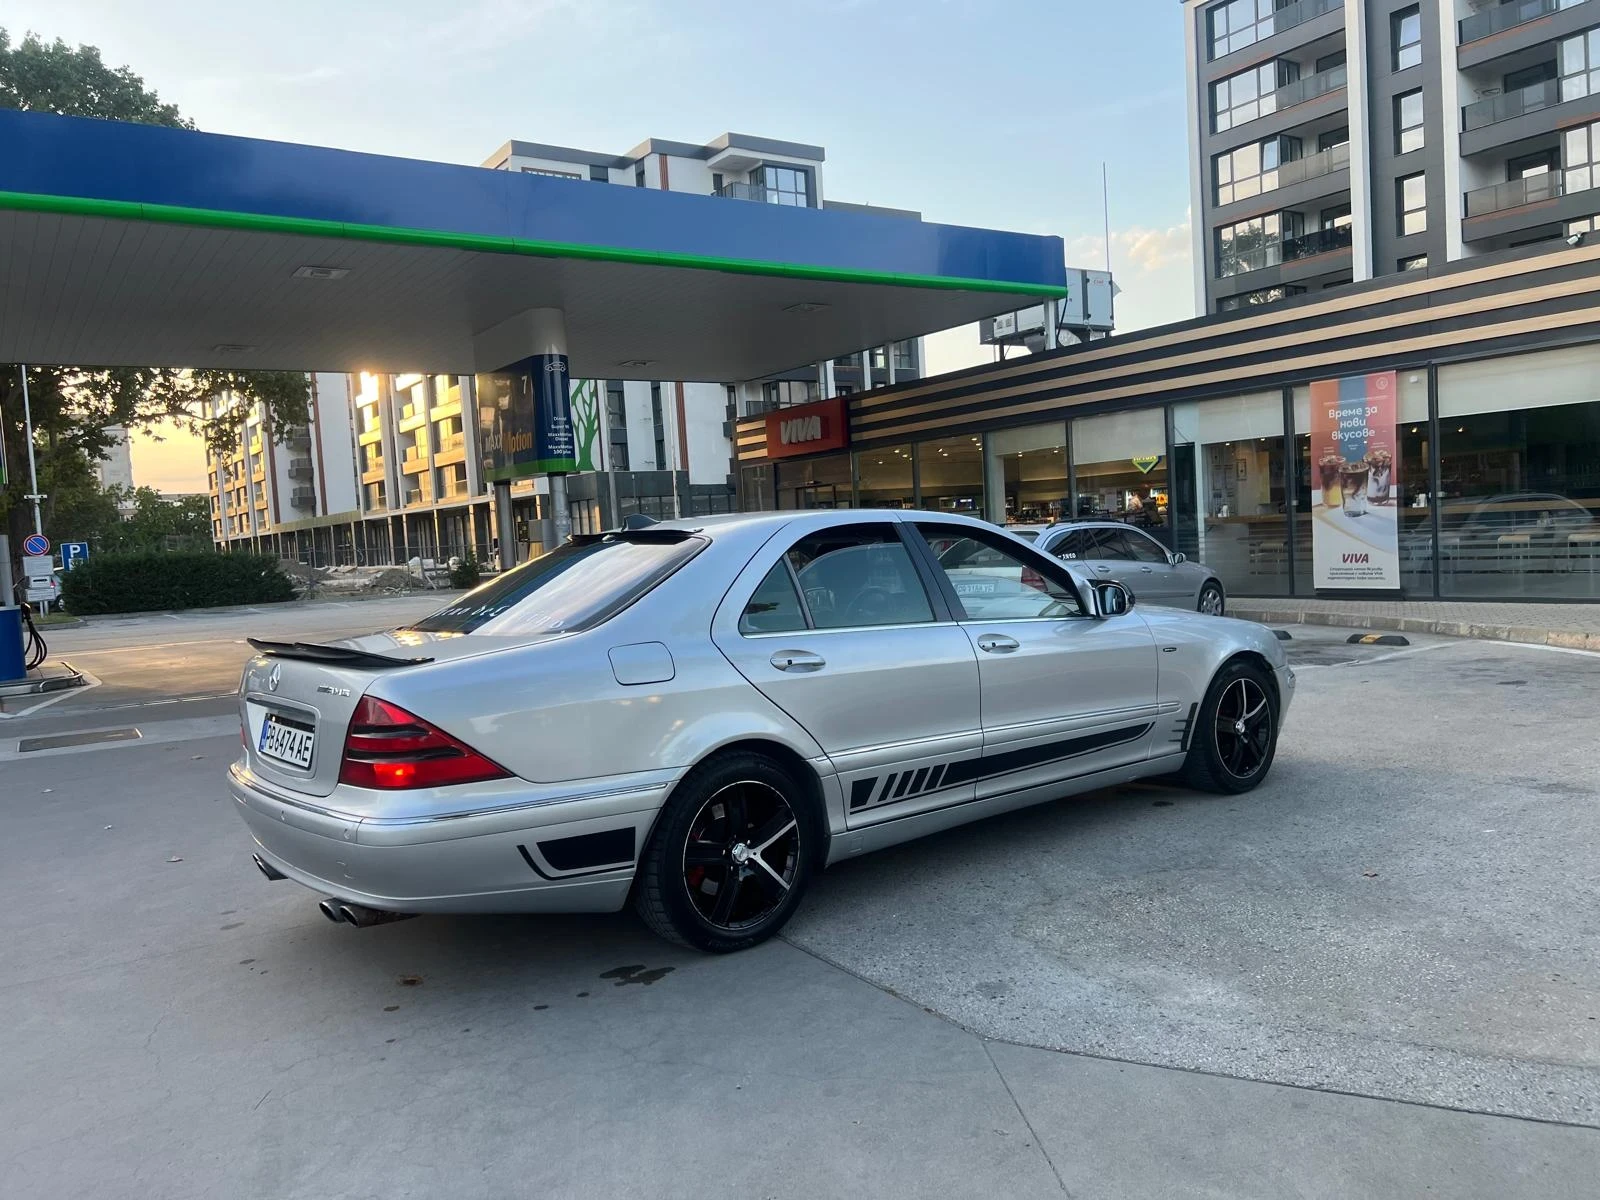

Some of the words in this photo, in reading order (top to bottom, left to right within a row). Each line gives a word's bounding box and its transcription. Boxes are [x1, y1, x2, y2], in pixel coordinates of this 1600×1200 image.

[521, 375, 528, 394] 7
[1328, 407, 1363, 420] Време
[1364, 406, 1378, 417] за
[1340, 417, 1366, 428] нови
[780, 415, 822, 444] VIVA
[1331, 428, 1376, 441] вкусове
[69, 544, 81, 557] P
[1342, 553, 1369, 564] VIVA
